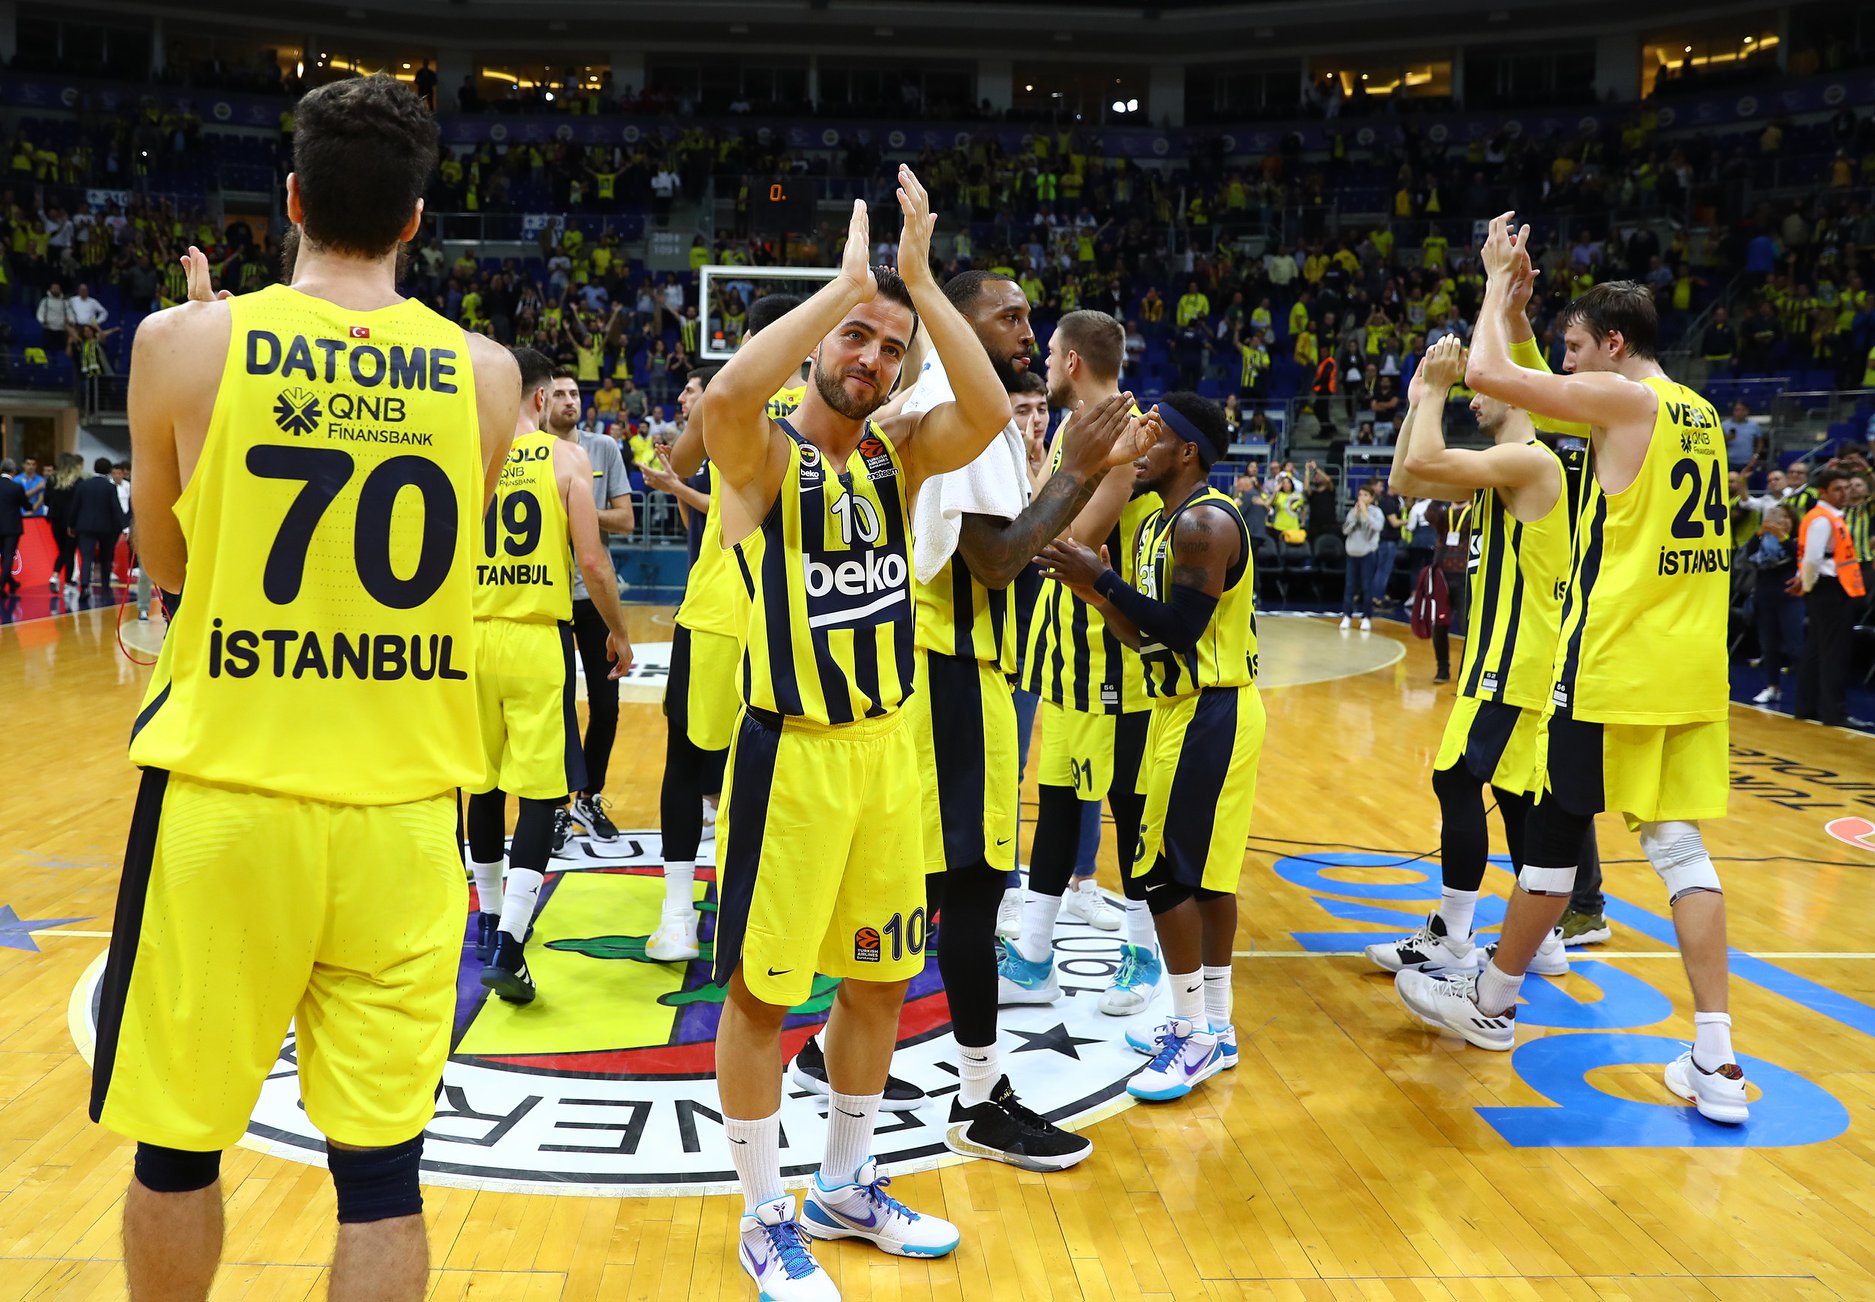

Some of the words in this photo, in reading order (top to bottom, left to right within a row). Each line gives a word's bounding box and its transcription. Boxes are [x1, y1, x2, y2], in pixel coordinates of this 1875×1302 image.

[246, 330, 458, 394] DATOME
[328, 393, 406, 422] QNB
[327, 422, 433, 446] FINANSBANK
[504, 446, 550, 465] OLO
[800, 469, 819, 478] beko
[1671, 458, 1728, 539] 24
[245, 444, 459, 610] 70
[484, 489, 542, 558] 19
[831, 492, 880, 545] 10
[476, 564, 554, 586] TANBUL
[802, 549, 907, 597] beko
[1658, 545, 1730, 576] İSTANBU
[209, 617, 468, 681] İSTANBUL
[882, 906, 926, 961] 10
